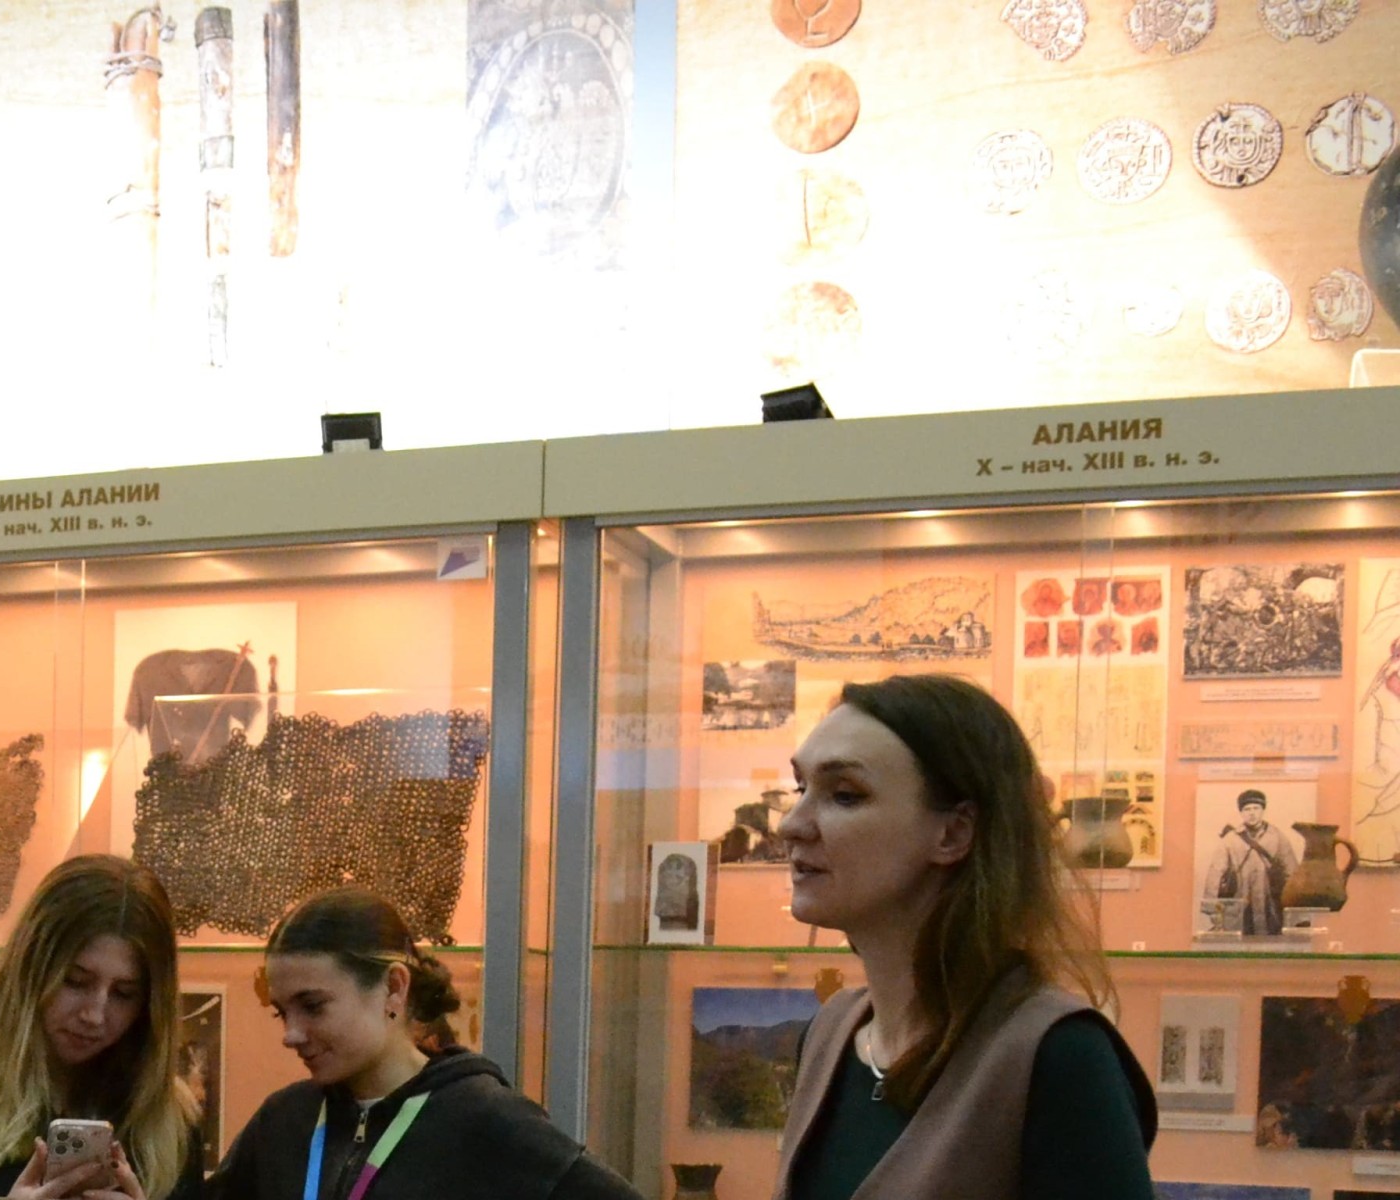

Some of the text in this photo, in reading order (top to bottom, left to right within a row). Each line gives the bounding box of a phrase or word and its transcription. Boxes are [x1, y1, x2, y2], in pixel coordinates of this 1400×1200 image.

[1032, 418, 1163, 446] АЛАНИЯ
[1021, 457, 1073, 474] нач.
[1083, 451, 1125, 471] XIII
[1133, 453, 1155, 468] в.
[1165, 452, 1188, 466] н.
[1198, 450, 1220, 464] э.
[60, 482, 160, 509] АЛАНИИ
[3, 521, 42, 536] нач.
[50, 515, 81, 533] XIII
[87, 517, 104, 530] в.
[111, 516, 128, 529] н.
[135, 514, 152, 527] э.
